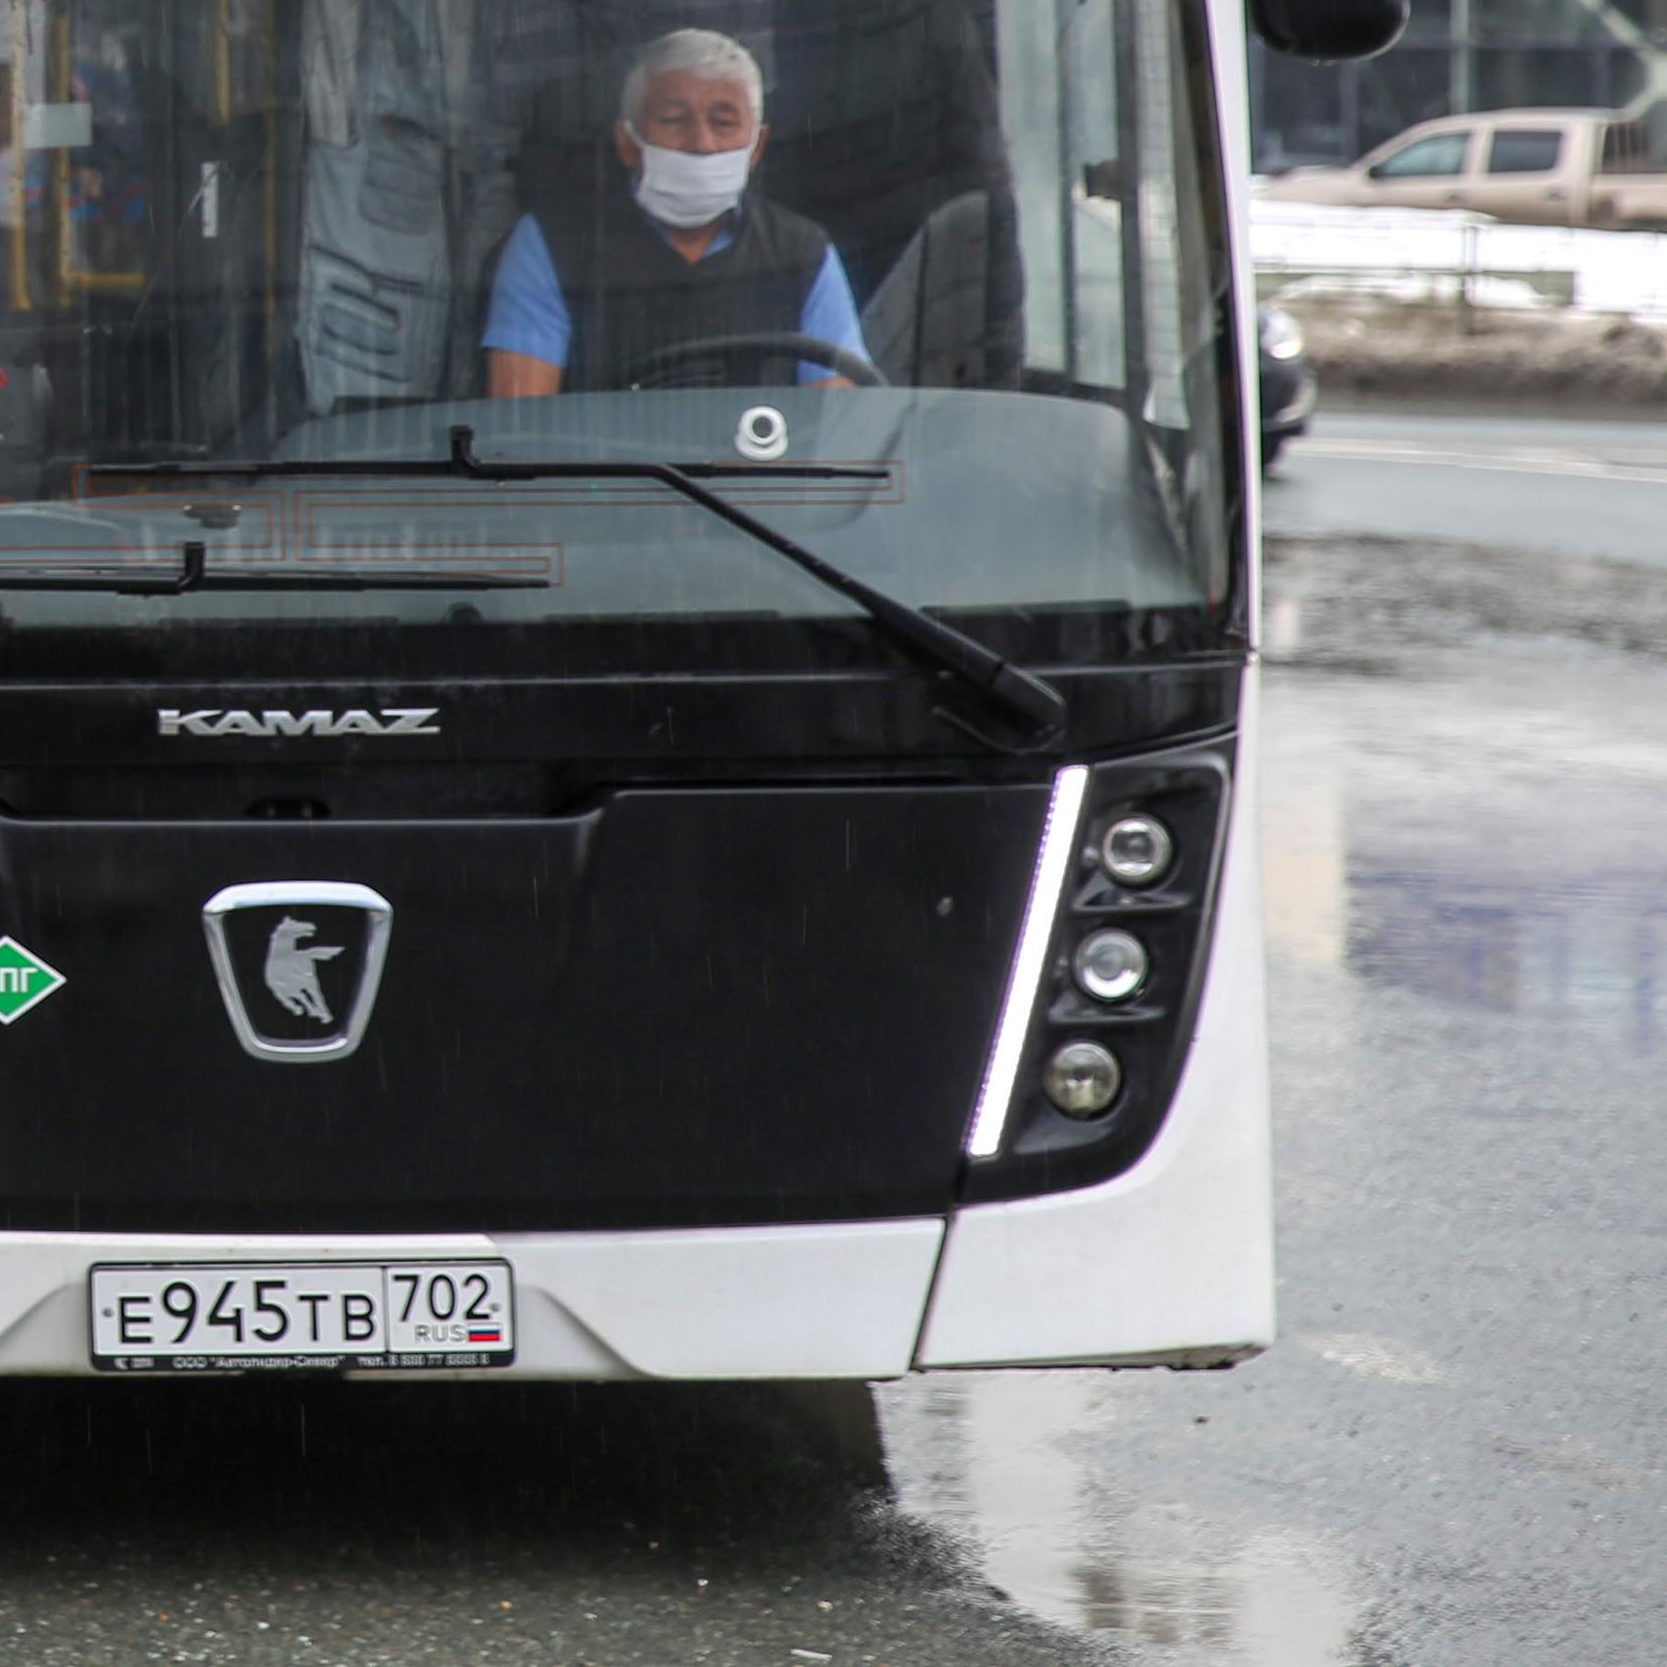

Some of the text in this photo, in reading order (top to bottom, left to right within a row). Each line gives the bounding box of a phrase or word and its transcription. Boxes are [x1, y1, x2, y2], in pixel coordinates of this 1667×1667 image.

[157, 707, 441, 736] KAMAZ
[392, 1273, 491, 1323] 702
[414, 1325, 465, 1343] RUS
